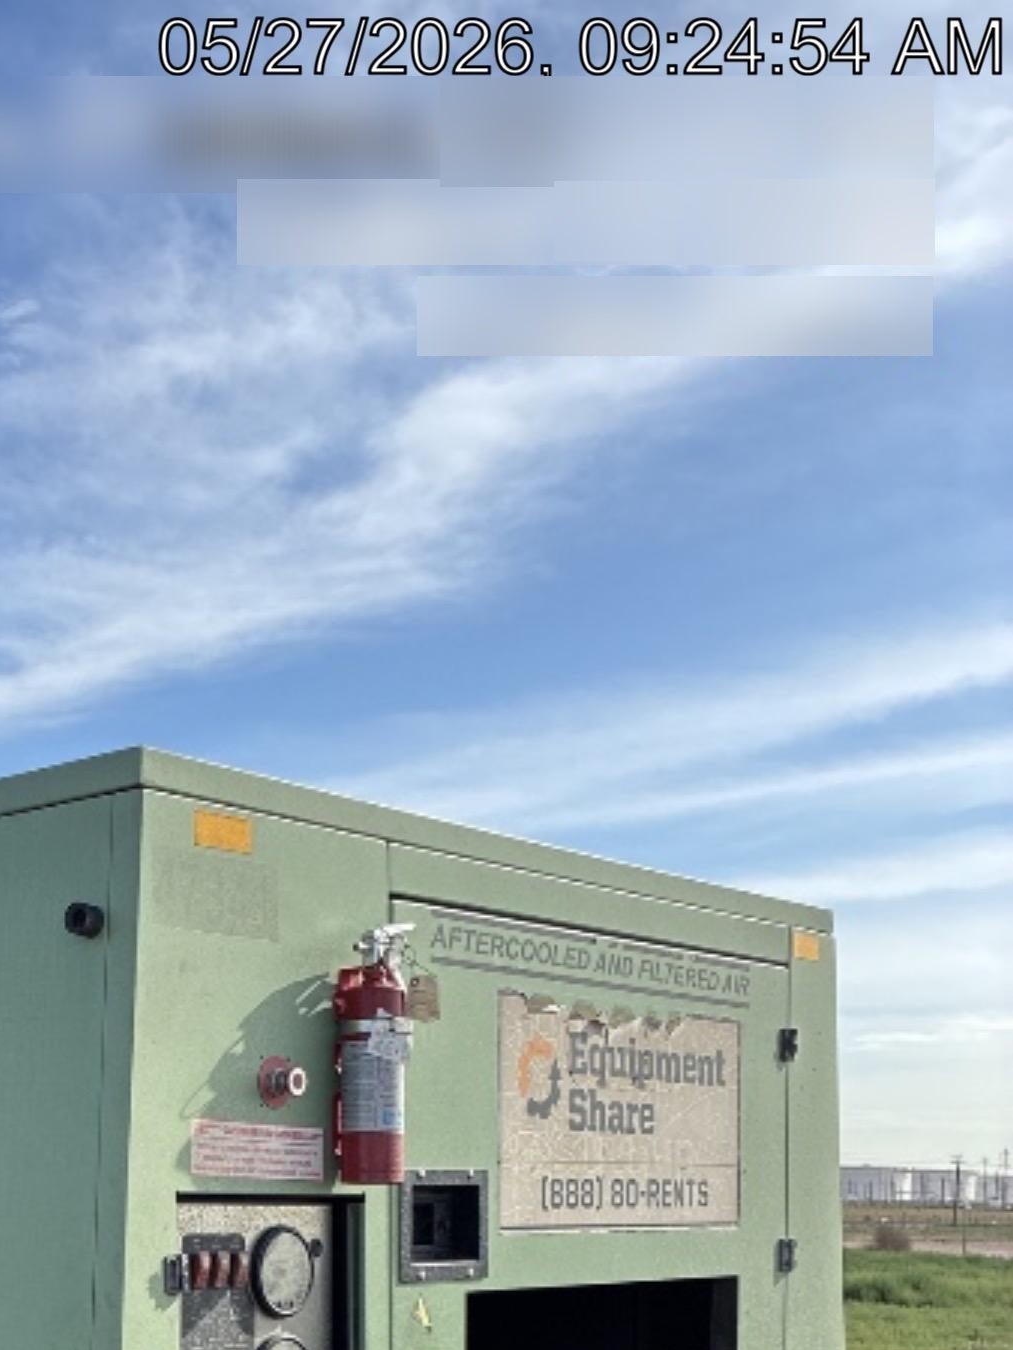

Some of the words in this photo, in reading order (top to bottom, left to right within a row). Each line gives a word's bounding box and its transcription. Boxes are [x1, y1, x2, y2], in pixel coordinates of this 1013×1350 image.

[431, 923, 589, 970] AFTERCOOLED
[593, 952, 633, 977] AND
[638, 958, 721, 992] FILTERED
[721, 968, 751, 996] AIR
[568, 1030, 726, 1089] Equipment
[568, 1088, 655, 1135] Share
[610, 1178, 709, 1208] 80-RENTS
